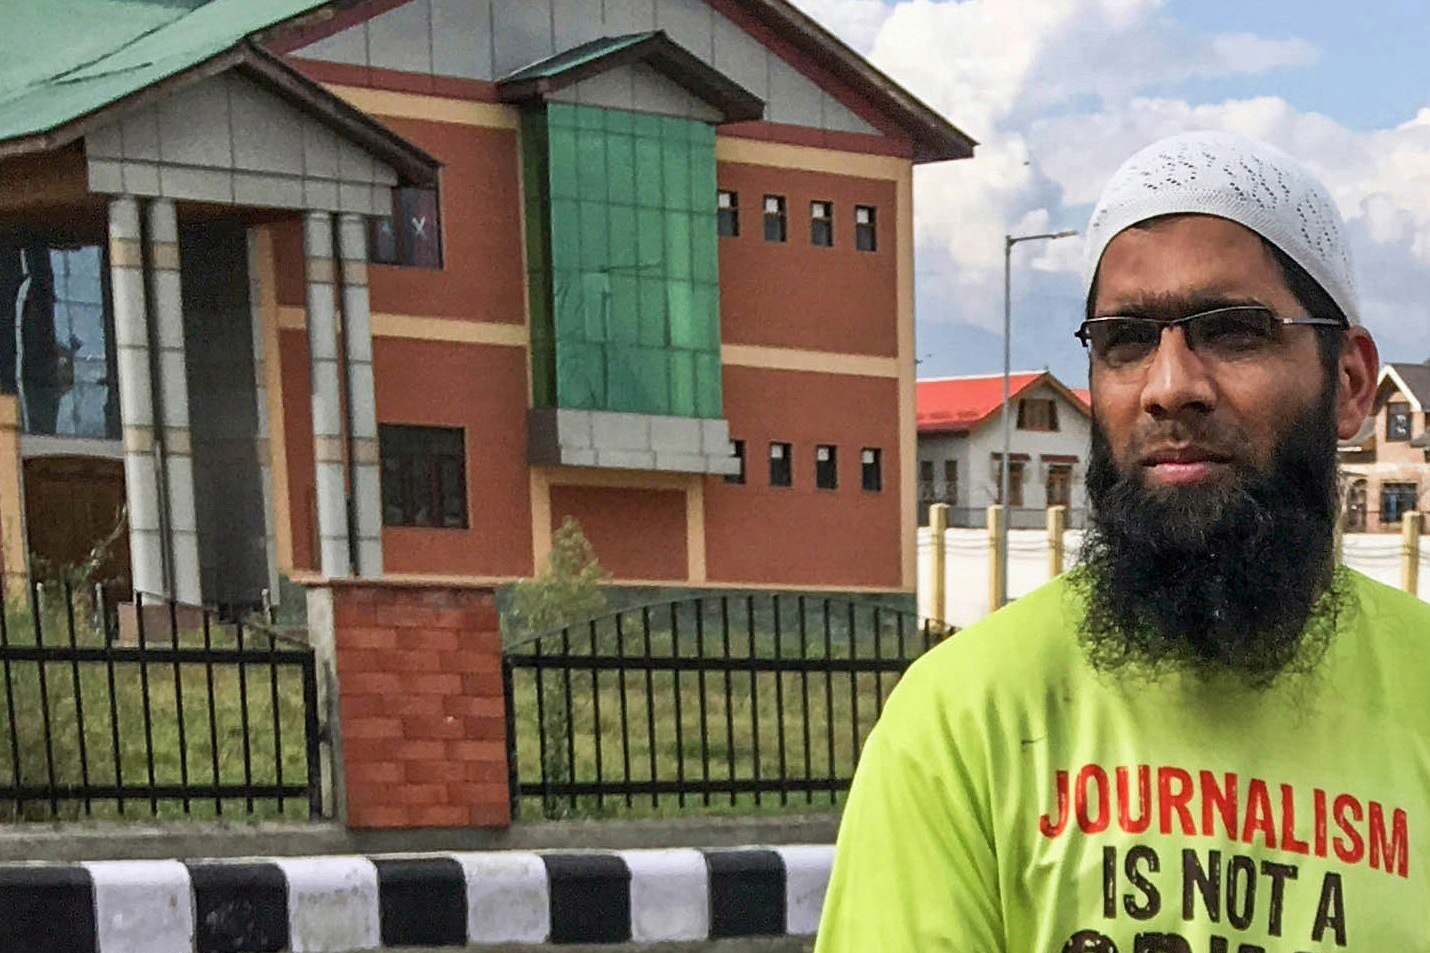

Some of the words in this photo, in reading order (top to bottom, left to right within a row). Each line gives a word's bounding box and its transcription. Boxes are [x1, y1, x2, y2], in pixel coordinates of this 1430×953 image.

[1039, 763, 1409, 878] JOURNALISM
[1102, 844, 1161, 920] IS
[1181, 848, 1299, 937] NOT
[1311, 871, 1347, 947] A
